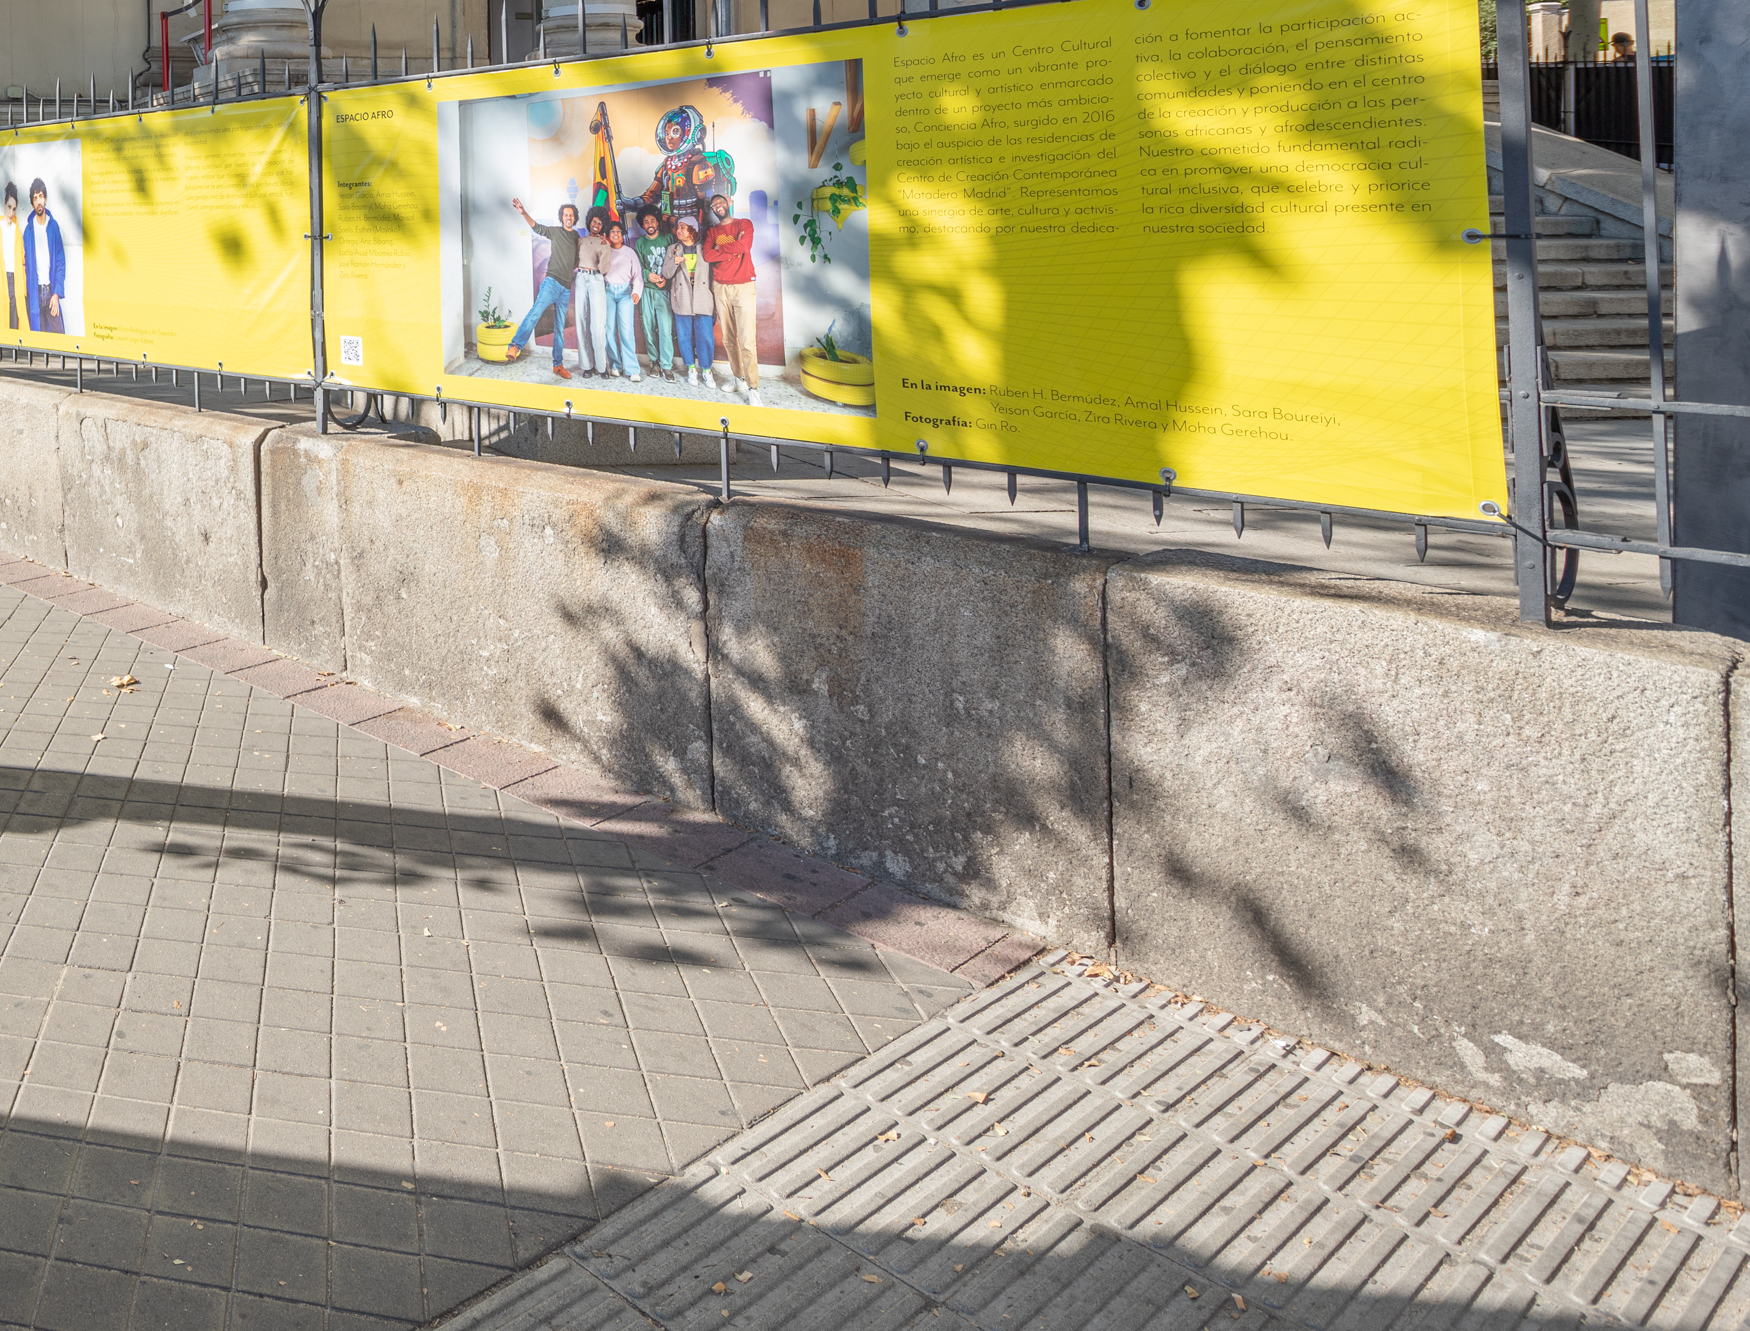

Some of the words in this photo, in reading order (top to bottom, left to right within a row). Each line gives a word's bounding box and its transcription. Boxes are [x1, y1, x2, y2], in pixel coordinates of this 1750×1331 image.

[893, 56, 935, 68] Espacio
[942, 52, 966, 64] Afro
[972, 53, 984, 61] es
[991, 50, 1005, 59] un
[1012, 45, 1054, 57] Centro
[1060, 37, 1112, 52] Cultural
[894, 75, 914, 86] que
[920, 71, 961, 83] emerge
[968, 68, 1001, 79] como
[1008, 66, 1022, 75] un
[1028, 60, 1078, 73] vibrante
[1086, 57, 1112, 71] pro-
[895, 91, 923, 103] yecto
[928, 86, 970, 98] cultural
[975, 88, 981, 97] y
[988, 81, 1033, 94] artístico
[1040, 74, 1113, 90] enmarcado
[336, 112, 369, 123] ESPACIO
[371, 110, 393, 120] AFRO
[895, 106, 930, 117] dentro
[934, 105, 948, 115] de
[953, 105, 967, 113] un
[972, 101, 1022, 115] proyecto
[1027, 97, 1053, 108] más
[1058, 94, 1113, 107] ambicio-
[896, 124, 910, 134] so,
[914, 121, 977, 133] Conciencia
[981, 118, 1009, 130] Afro,
[1014, 113, 1058, 129] surgido
[1062, 116, 1077, 124] en
[1082, 110, 1115, 123] 2016
[896, 139, 920, 152] bajo
[923, 139, 933, 149] el
[936, 137, 984, 150] auspicio
[987, 135, 1002, 146] de
[1006, 134, 1023, 146] las
[1026, 130, 1095, 144] residencias
[1099, 130, 1116, 141] de
[897, 156, 942, 167] creación
[948, 154, 993, 165] artística
[999, 155, 1005, 163] e
[1011, 149, 1090, 164] investigación
[1097, 148, 1116, 159] del
[338, 181, 372, 190] Integrantes:
[897, 172, 934, 183] Centro
[938, 172, 952, 182] de
[956, 170, 1009, 181] Creación
[1013, 168, 1117, 181] Contemporánea
[1020, 186, 1118, 200] Representamos
[898, 208, 919, 217] una
[922, 206, 965, 218] sinergia
[969, 206, 984, 216] de
[987, 207, 1014, 217] arte,
[1018, 204, 1060, 215] cultura
[1064, 207, 1070, 217] y
[1074, 204, 1118, 215] activis-
[899, 225, 919, 235] mo,
[923, 223, 991, 233] destacando
[995, 224, 1015, 235] por
[1020, 224, 1066, 233] nuestra
[1071, 222, 1119, 233] dedica-
[902, 378, 918, 390] En
[921, 380, 932, 391] la
[935, 381, 986, 397] imagen:
[990, 385, 1029, 399] Ruben
[1033, 388, 1047, 400] H.
[1051, 390, 1120, 408] Bermúdez,
[1125, 396, 1161, 411] Amal
[1166, 400, 1227, 417] Hussein,
[1231, 404, 1268, 419] Sara
[1273, 407, 1341, 428] Boureiyi,
[904, 411, 972, 429] Fotografía:
[975, 418, 997, 431] Gin
[1001, 421, 1021, 433] Ro.
[991, 402, 1030, 417] Yeison
[1033, 406, 1080, 423] García,
[1084, 410, 1110, 424] Zira
[1114, 414, 1157, 429] Rivera
[1161, 422, 1169, 433] y
[1173, 419, 1216, 434] Moha
[1221, 423, 1292, 441] Gerehou.
